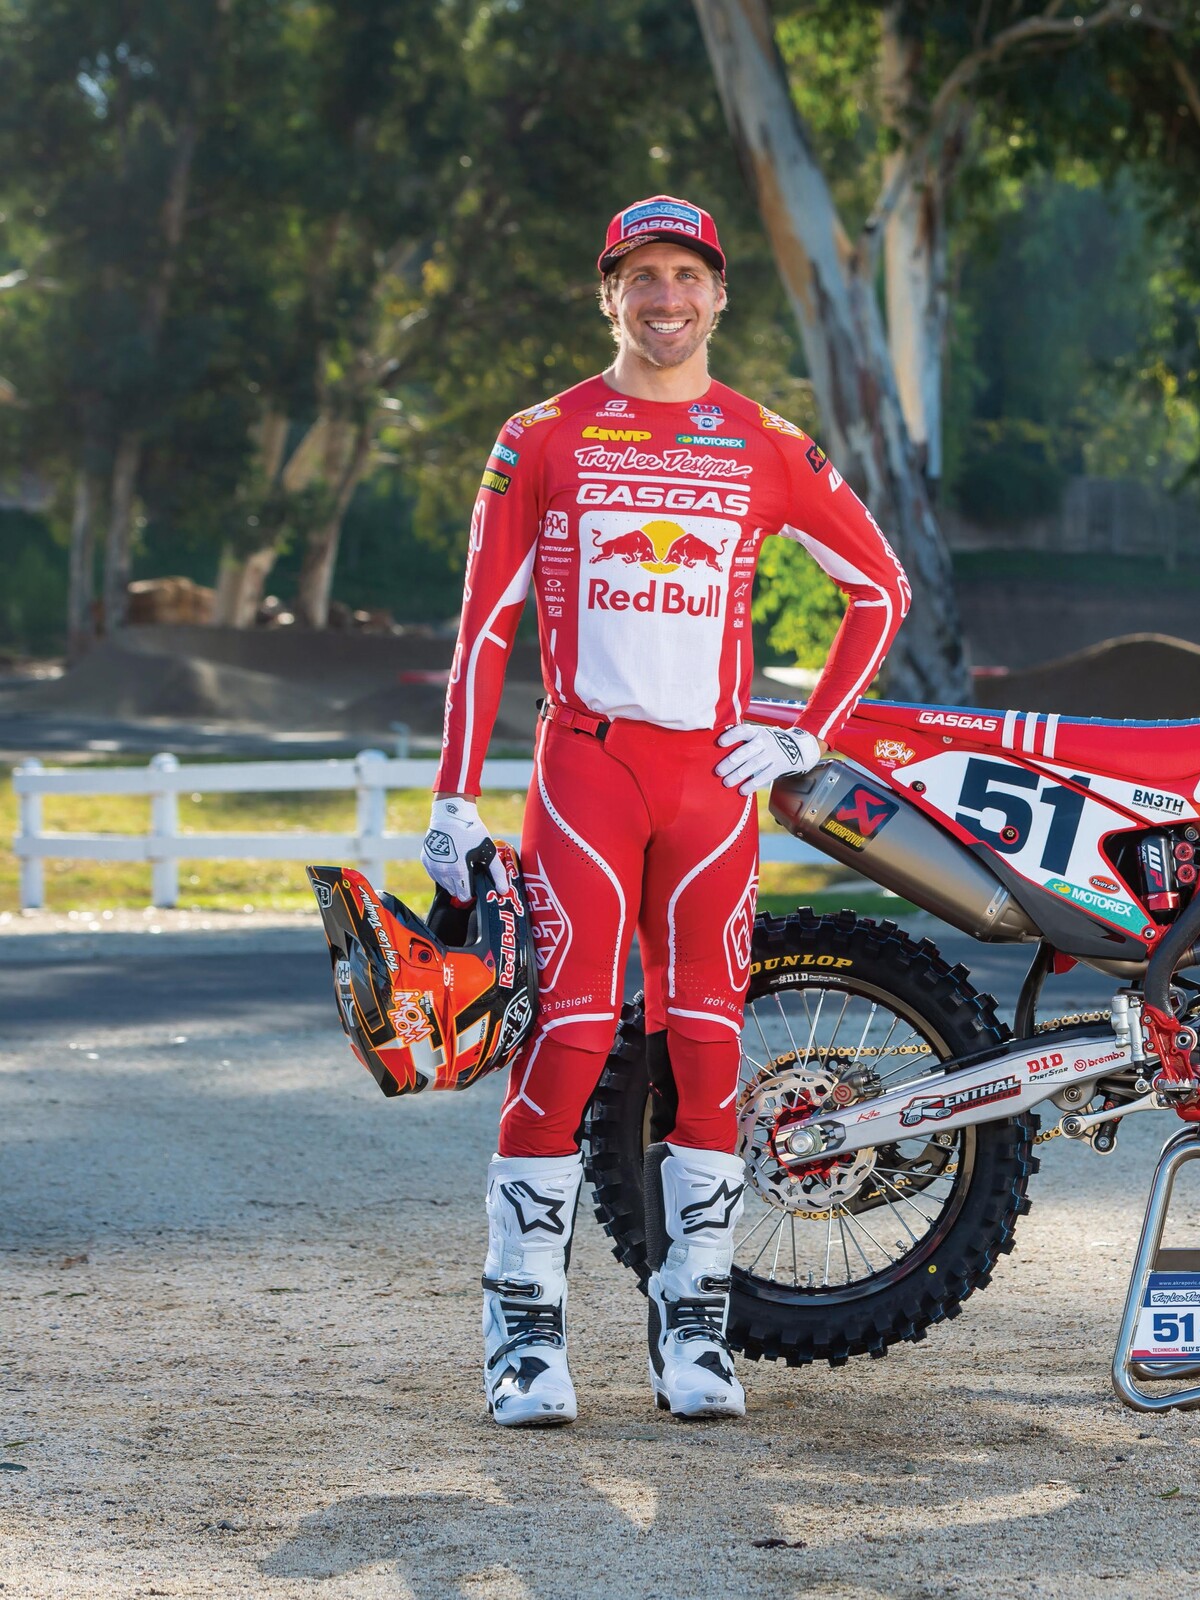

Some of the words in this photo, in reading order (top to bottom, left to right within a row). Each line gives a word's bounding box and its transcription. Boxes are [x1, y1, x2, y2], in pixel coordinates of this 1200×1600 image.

[627, 219, 697, 235] GASGAS
[688, 403, 723, 416] AMA
[693, 437, 744, 448] MOTOREX
[574, 445, 621, 471] Troy
[620, 446, 662, 470] Lee
[662, 449, 753, 478] Designs
[576, 483, 751, 517] GASGAS
[545, 513, 567, 536] PPG
[587, 578, 657, 612] Red
[661, 582, 721, 618] Bull
[918, 711, 998, 732] GASGAS
[1132, 789, 1184, 813] BN3TH
[955, 757, 1091, 877] 51
[1148, 844, 1164, 888] WP
[1092, 878, 1108, 888] Twin
[1107, 884, 1120, 892] Air
[358, 886, 382, 930] Designs
[1071, 887, 1134, 918] MOTOREX
[378, 929, 393, 950] Lee
[499, 911, 516, 950] Bull
[385, 950, 400, 973] Troy
[498, 948, 515, 988] Red
[750, 954, 854, 976] DUNLOP
[555, 994, 594, 1010] DESIGNS
[703, 997, 726, 1007] TROY
[727, 1003, 737, 1012] LEE
[1088, 1051, 1126, 1067] brembo
[954, 1088, 1020, 1111] CHAINWHEELS
[1152, 1292, 1170, 1304] Troy
[1168, 1292, 1186, 1302] Lee
[1153, 1312, 1194, 1342] 51
